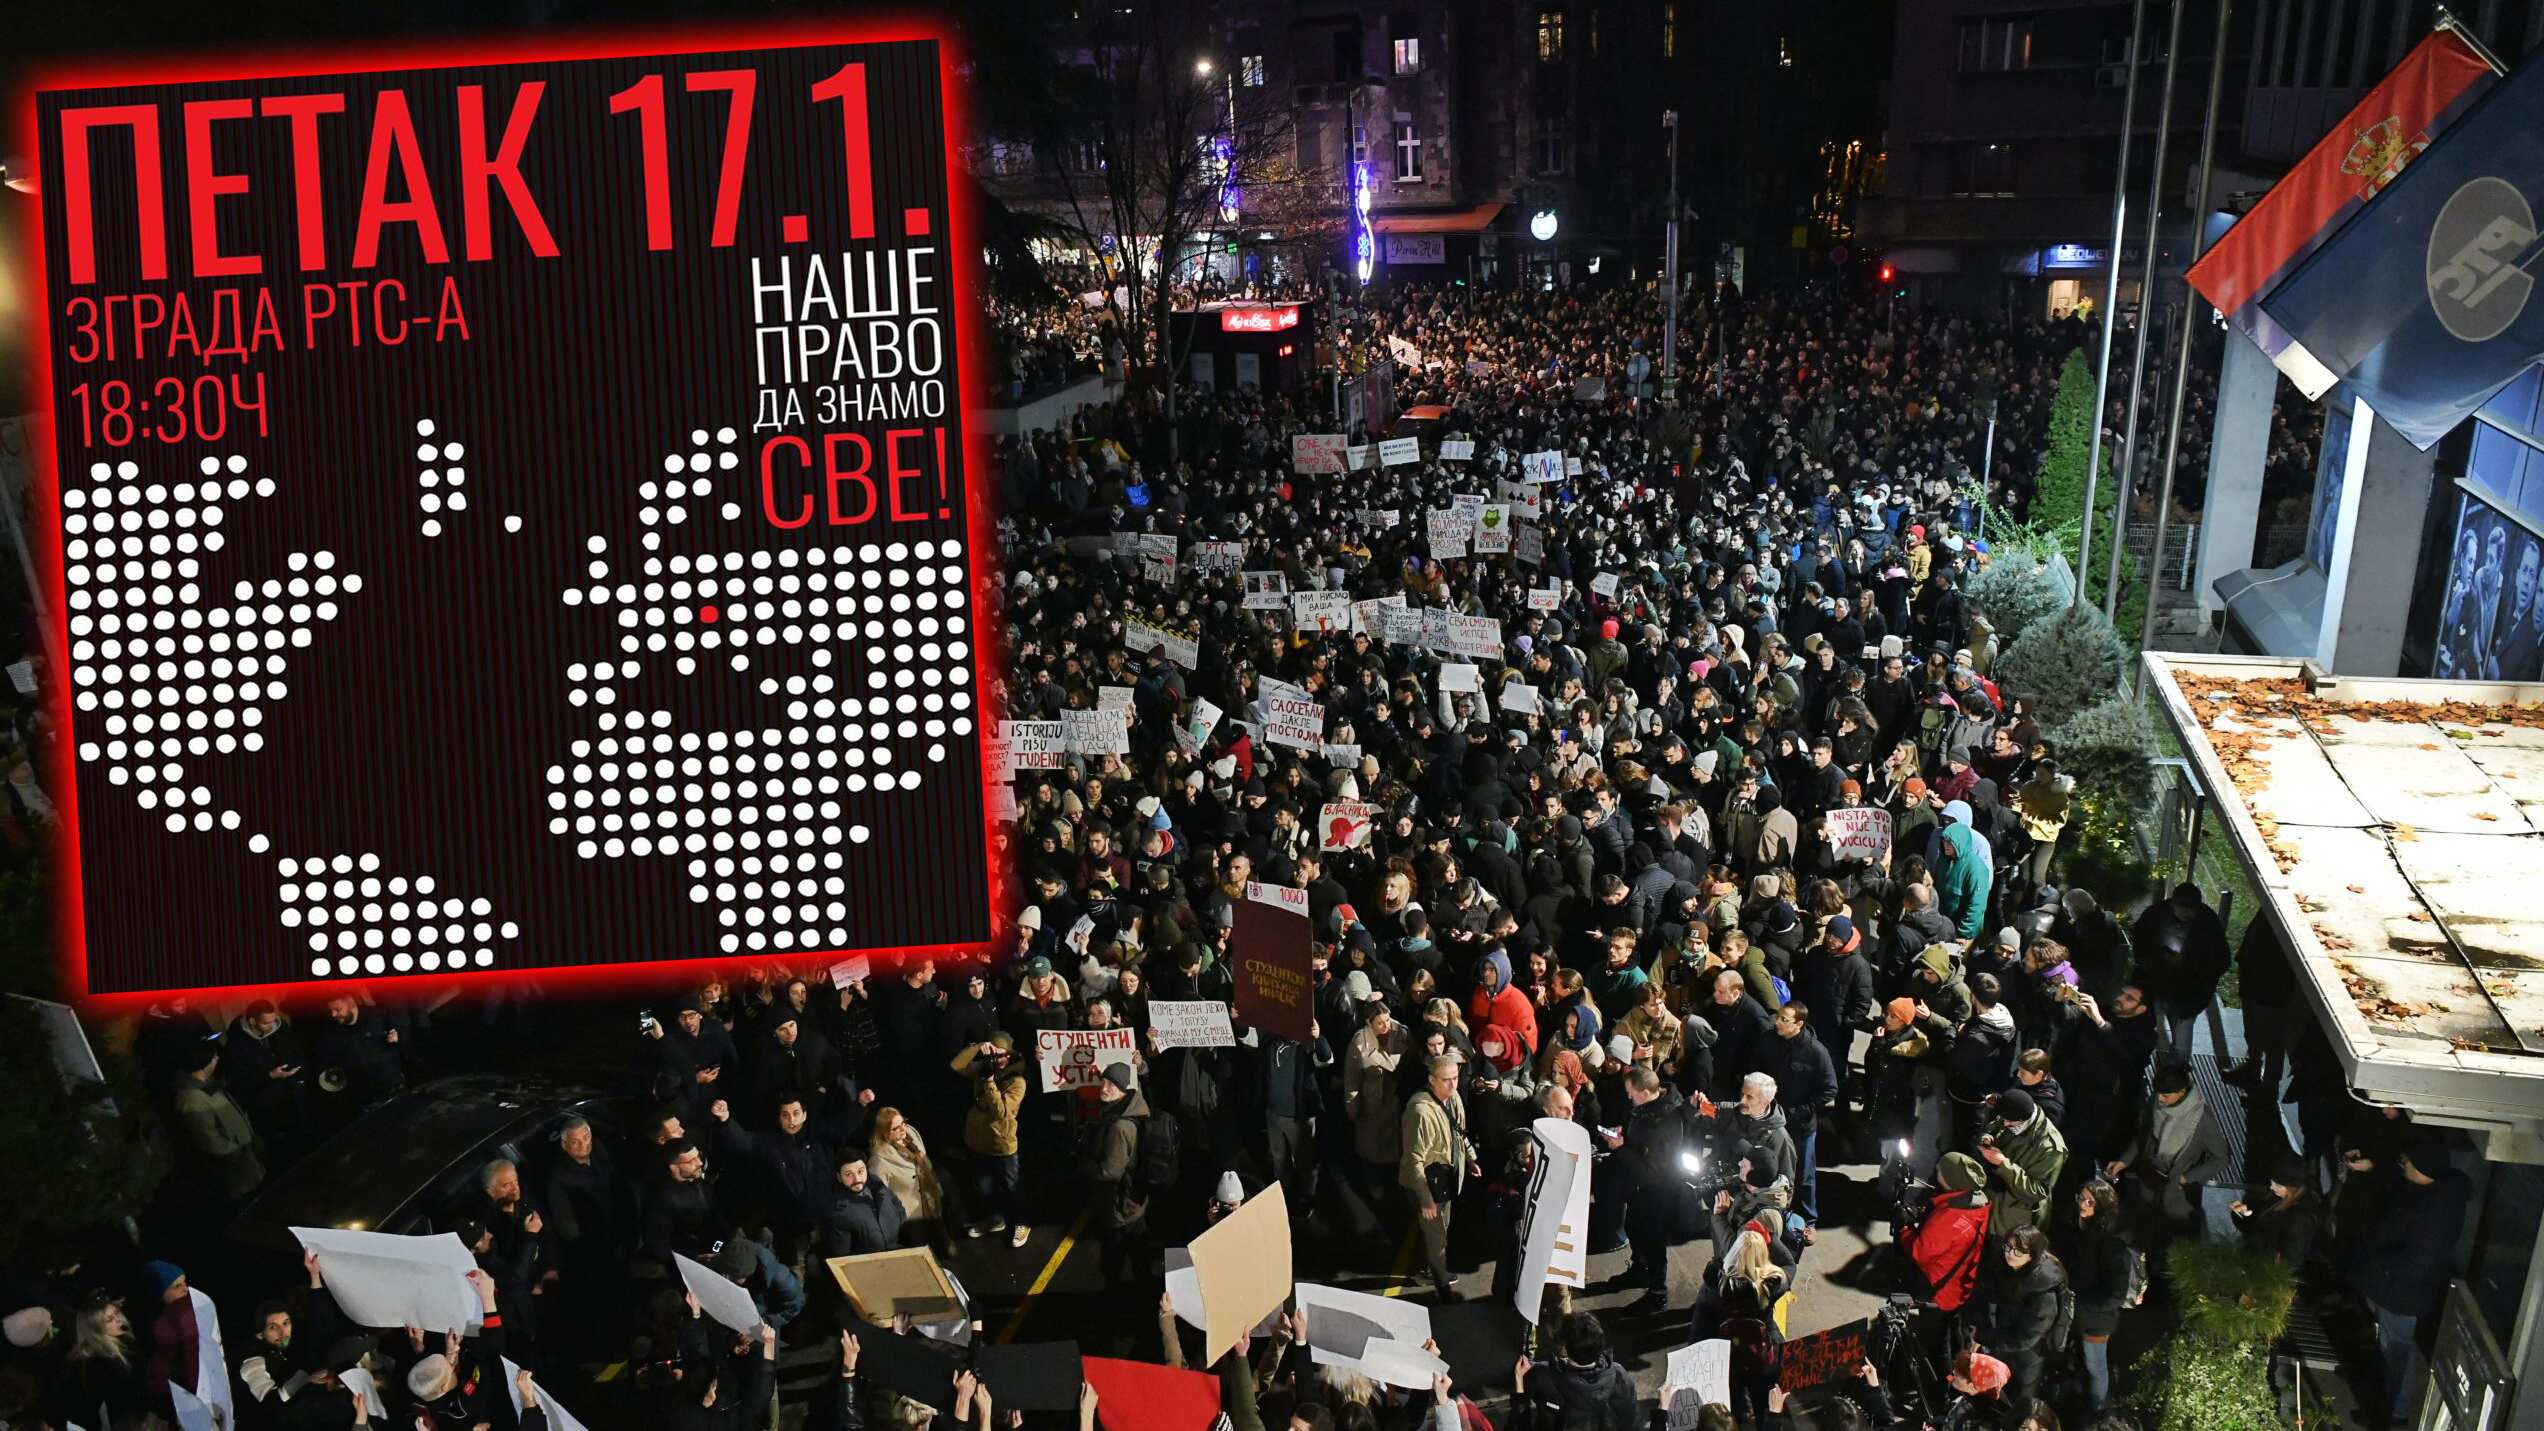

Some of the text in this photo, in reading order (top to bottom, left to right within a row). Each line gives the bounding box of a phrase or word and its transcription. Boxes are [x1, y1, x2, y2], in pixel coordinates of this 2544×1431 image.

[1206, 543, 1228, 556] РТС
[1223, 555, 1239, 567] СЕ
[1300, 592, 1348, 603] МИ НИСМО
[1309, 602, 1333, 612] ВАША
[1449, 616, 1467, 627] СВИ
[1469, 618, 1486, 628] СМО
[1061, 710, 1125, 722] ЗАЈЕДНО СМО
[1281, 713, 1311, 729] ДАКЛЕ
[1011, 723, 1063, 738] ISTORIJU
[1068, 722, 1119, 734] ЛЕПШИ
[1066, 732, 1126, 741] ЗАЈЕДНО СМО
[1023, 738, 1047, 751] PIŠU
[1078, 742, 1117, 755] ЈАЧИ
[1846, 822, 1870, 832] NIJE
[1280, 888, 1304, 904] 1000
[1151, 1003, 1226, 1016] КОМЕ ЗАКОН ЛЕЖИ
[1169, 1017, 1208, 1027] У ТОПУЗУ
[1191, 1027, 1201, 1037] МУ
[1203, 1026, 1231, 1036] СМРДЕ
[1040, 1030, 1130, 1050] СТУДЕНТИ
[1073, 1049, 1095, 1064] СУ
